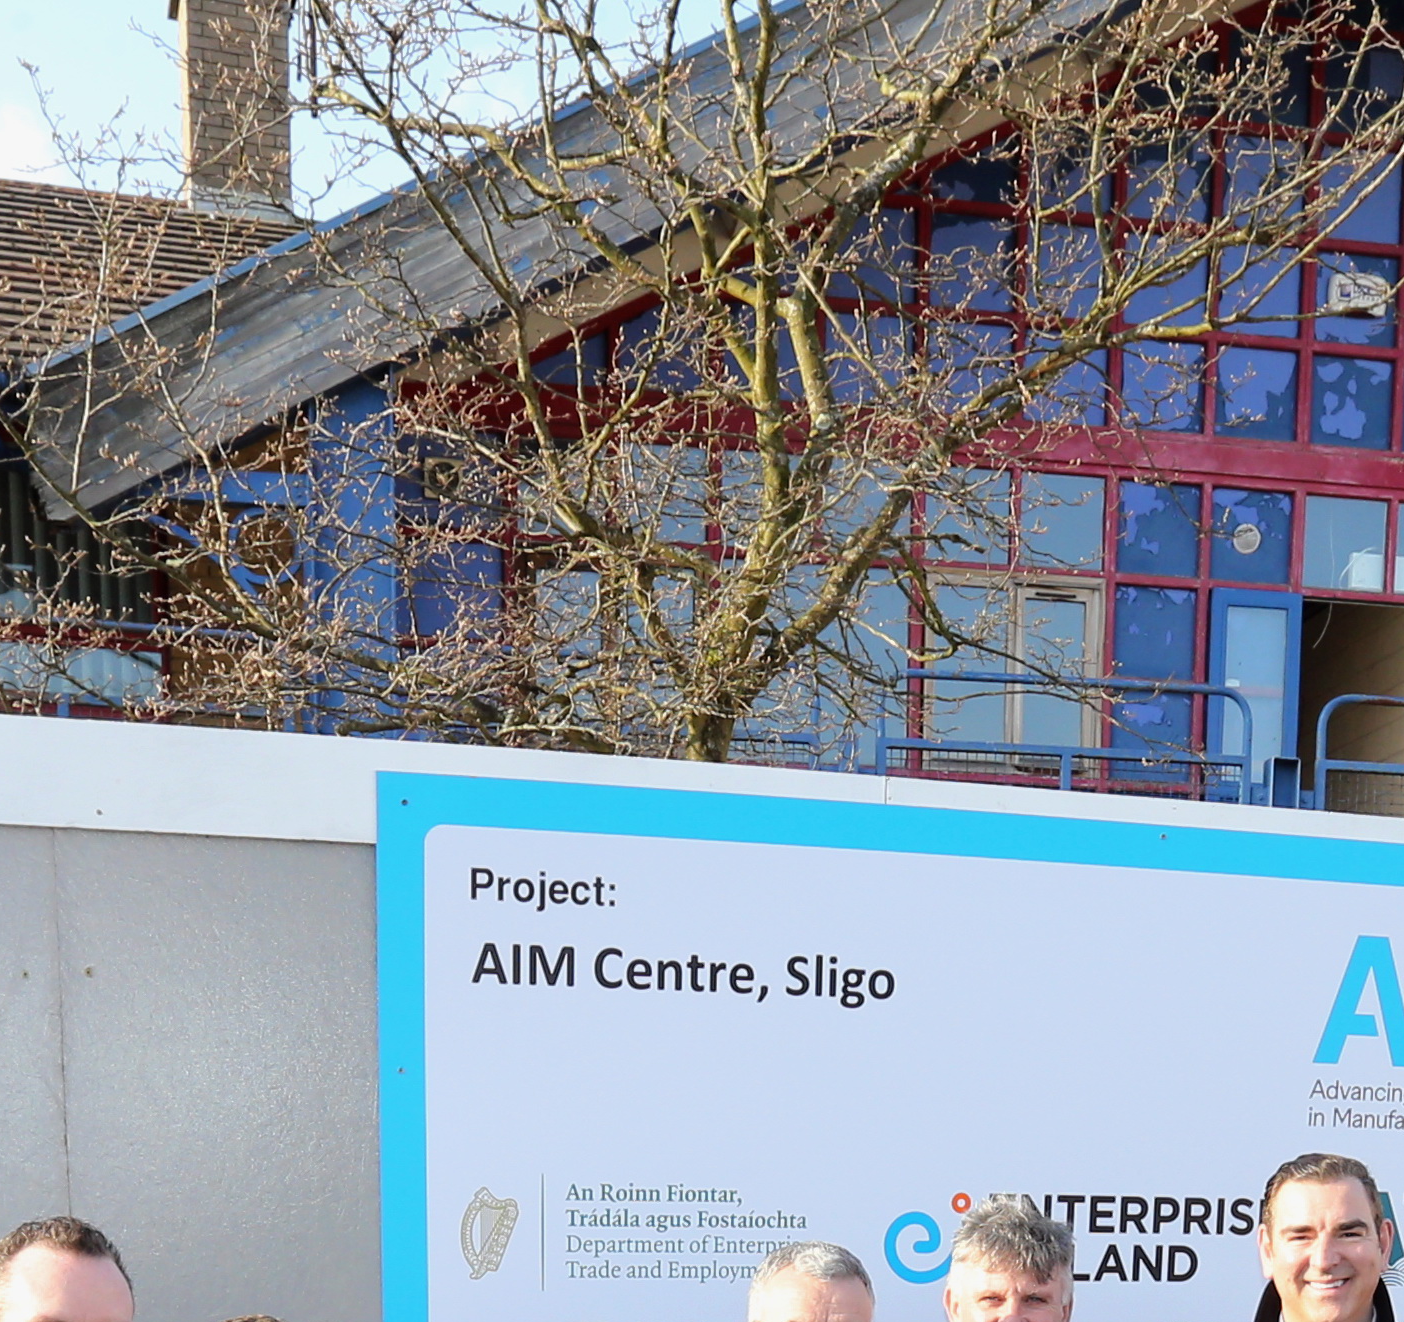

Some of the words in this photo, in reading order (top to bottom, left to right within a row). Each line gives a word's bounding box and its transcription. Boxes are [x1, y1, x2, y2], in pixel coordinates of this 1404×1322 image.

[470, 867, 617, 912] Project:
[471, 942, 576, 987] AIM
[595, 947, 769, 1003] Centre,
[785, 954, 896, 1009] Sligo
[1308, 1107, 1325, 1127] in
[565, 1184, 594, 1202] An
[600, 1183, 661, 1203] Roinn
[667, 1183, 743, 1207] Fiontar,
[566, 1208, 640, 1228] Trádála
[646, 1214, 692, 1232] agus
[696, 1209, 807, 1230] Fostaíochta
[566, 1234, 684, 1257] Department
[689, 1234, 712, 1254] of
[566, 1260, 621, 1279] Trade
[626, 1259, 662, 1279] and
